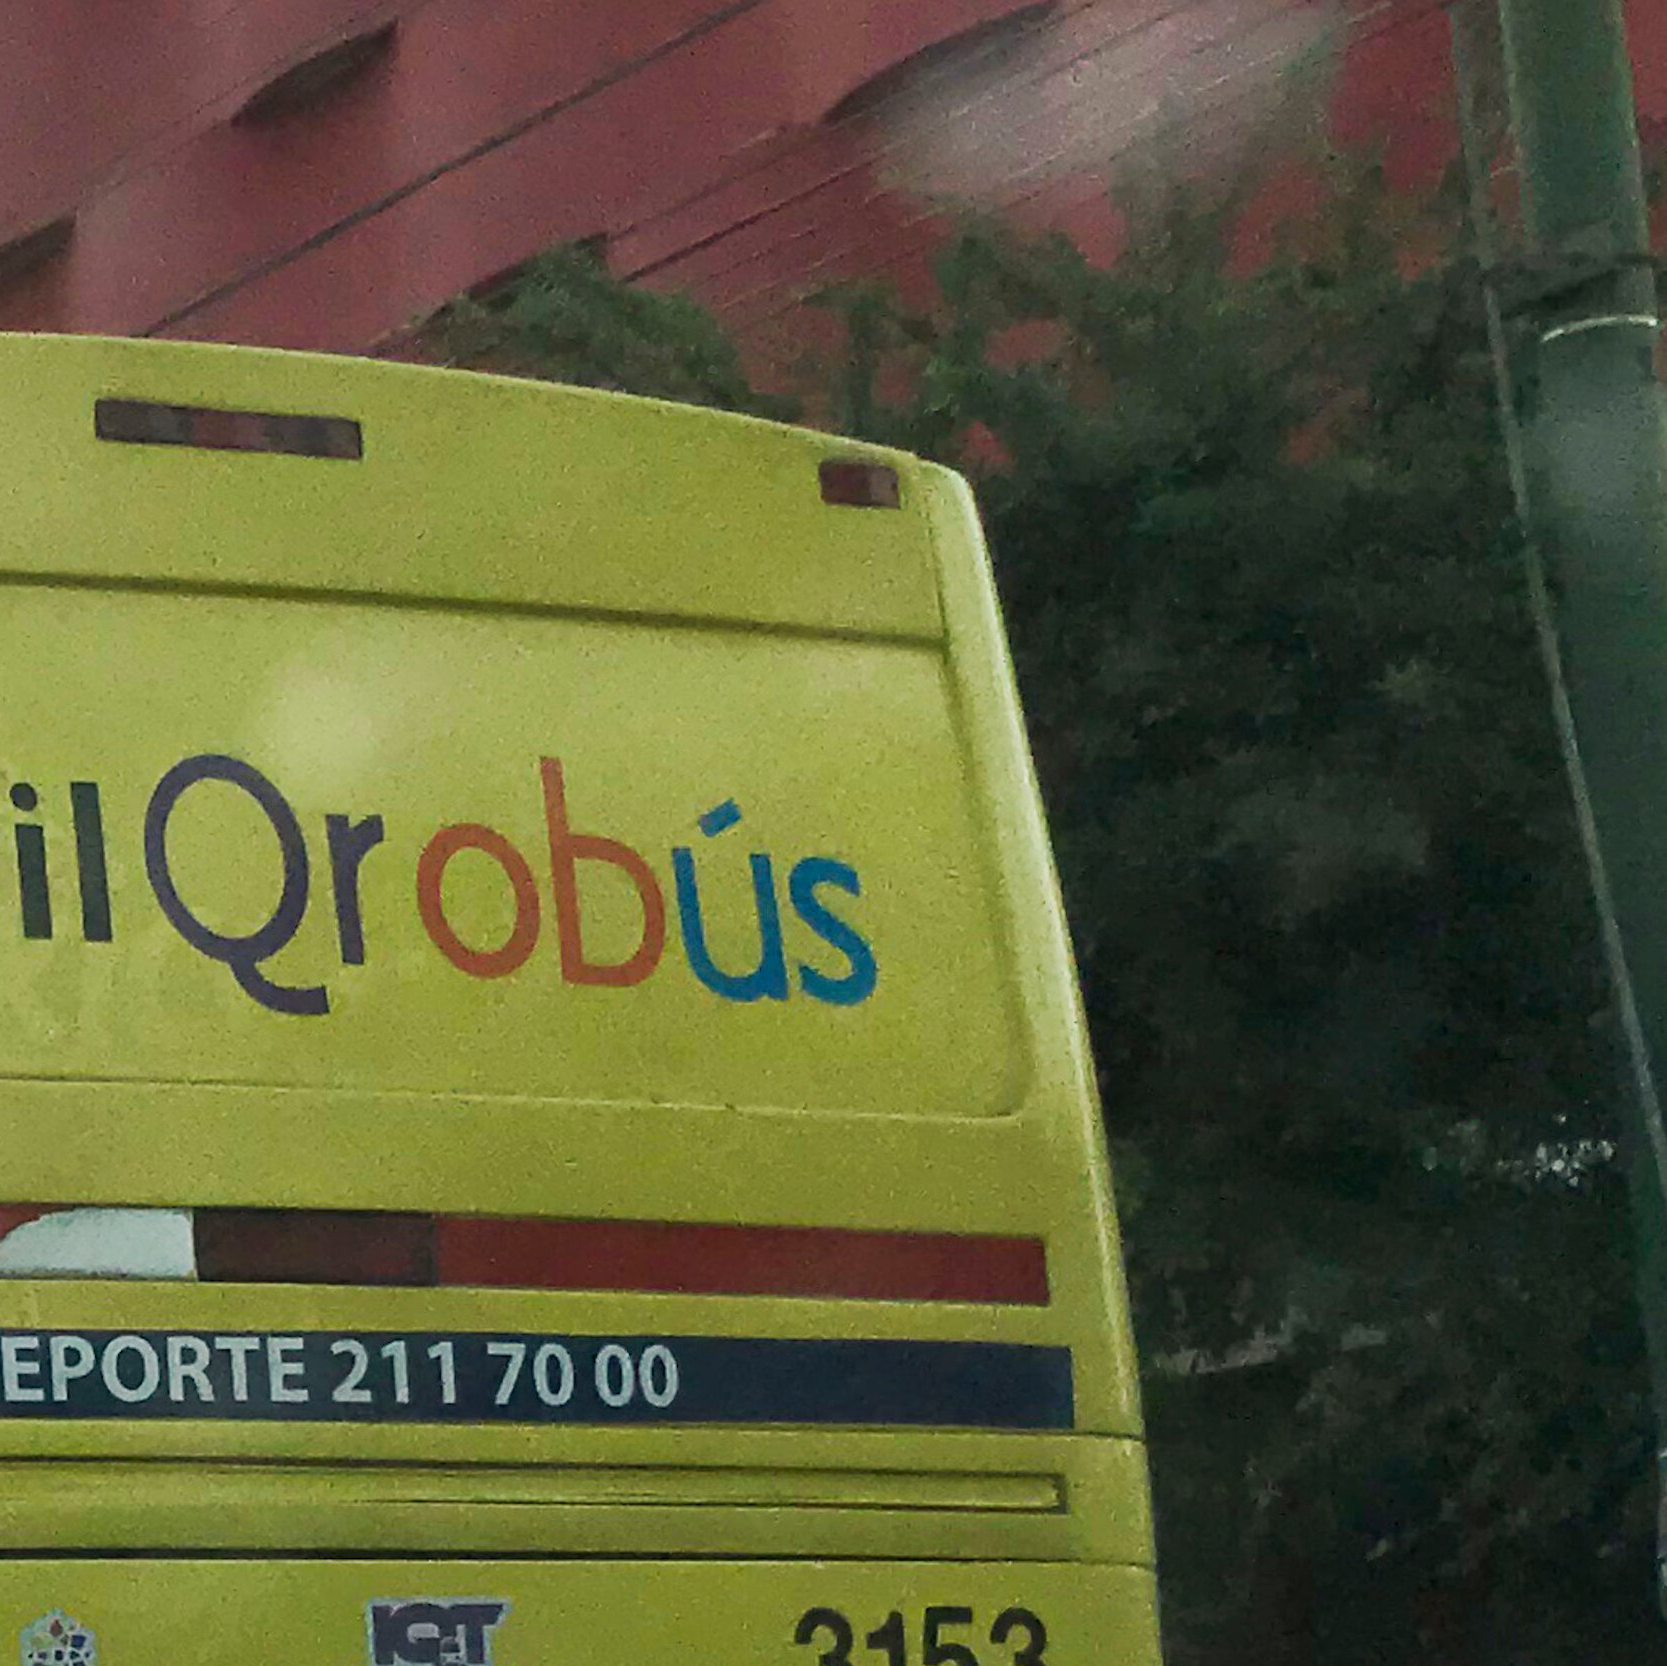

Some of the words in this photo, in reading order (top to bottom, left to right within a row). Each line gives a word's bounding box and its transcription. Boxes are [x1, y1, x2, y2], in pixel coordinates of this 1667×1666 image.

[330, 1338, 457, 1406] 211
[487, 1342, 575, 1407] 70
[594, 1344, 679, 1408] 00
